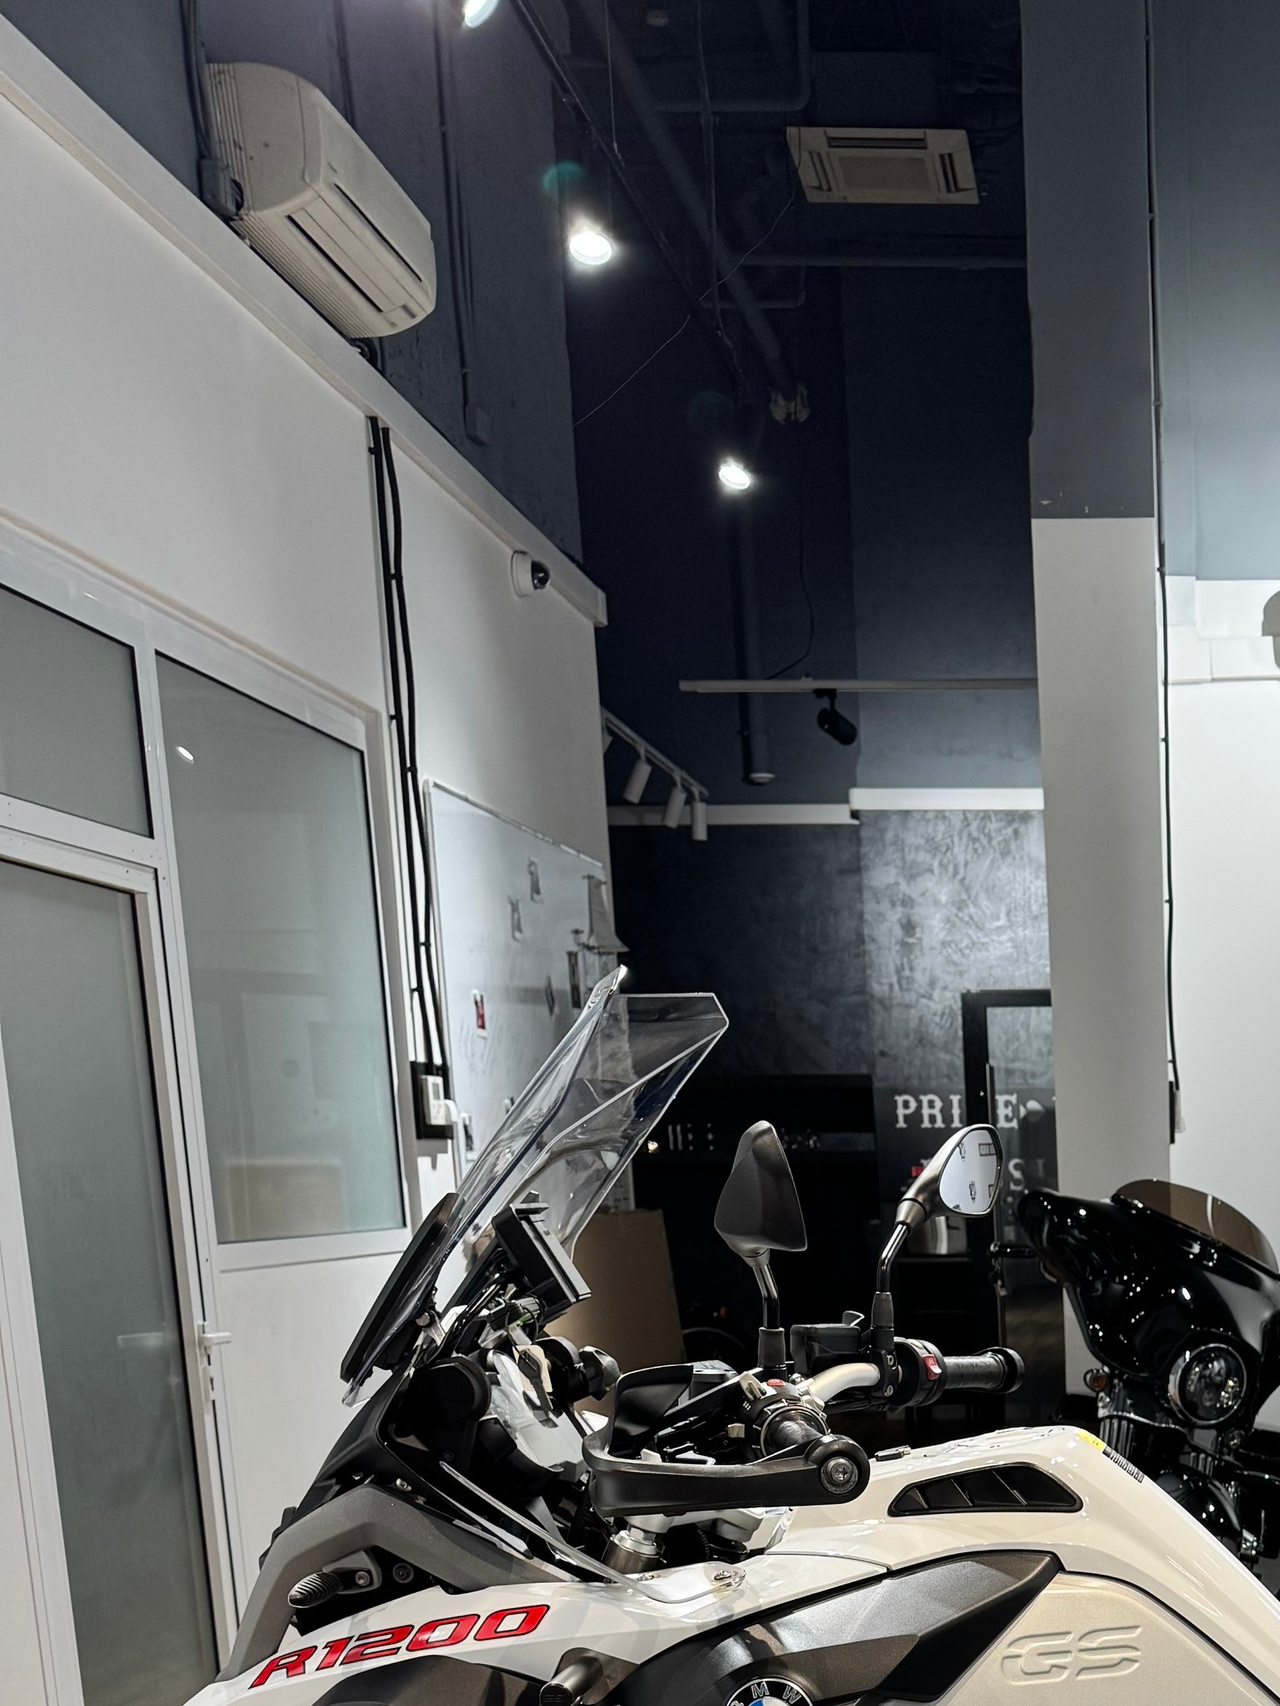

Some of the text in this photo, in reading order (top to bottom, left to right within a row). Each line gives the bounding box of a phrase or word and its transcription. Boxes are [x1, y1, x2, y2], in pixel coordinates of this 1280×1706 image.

[893, 1092, 1019, 1130] PRIE
[248, 1602, 552, 1690] R1200
[1001, 1624, 1142, 1686] GS
